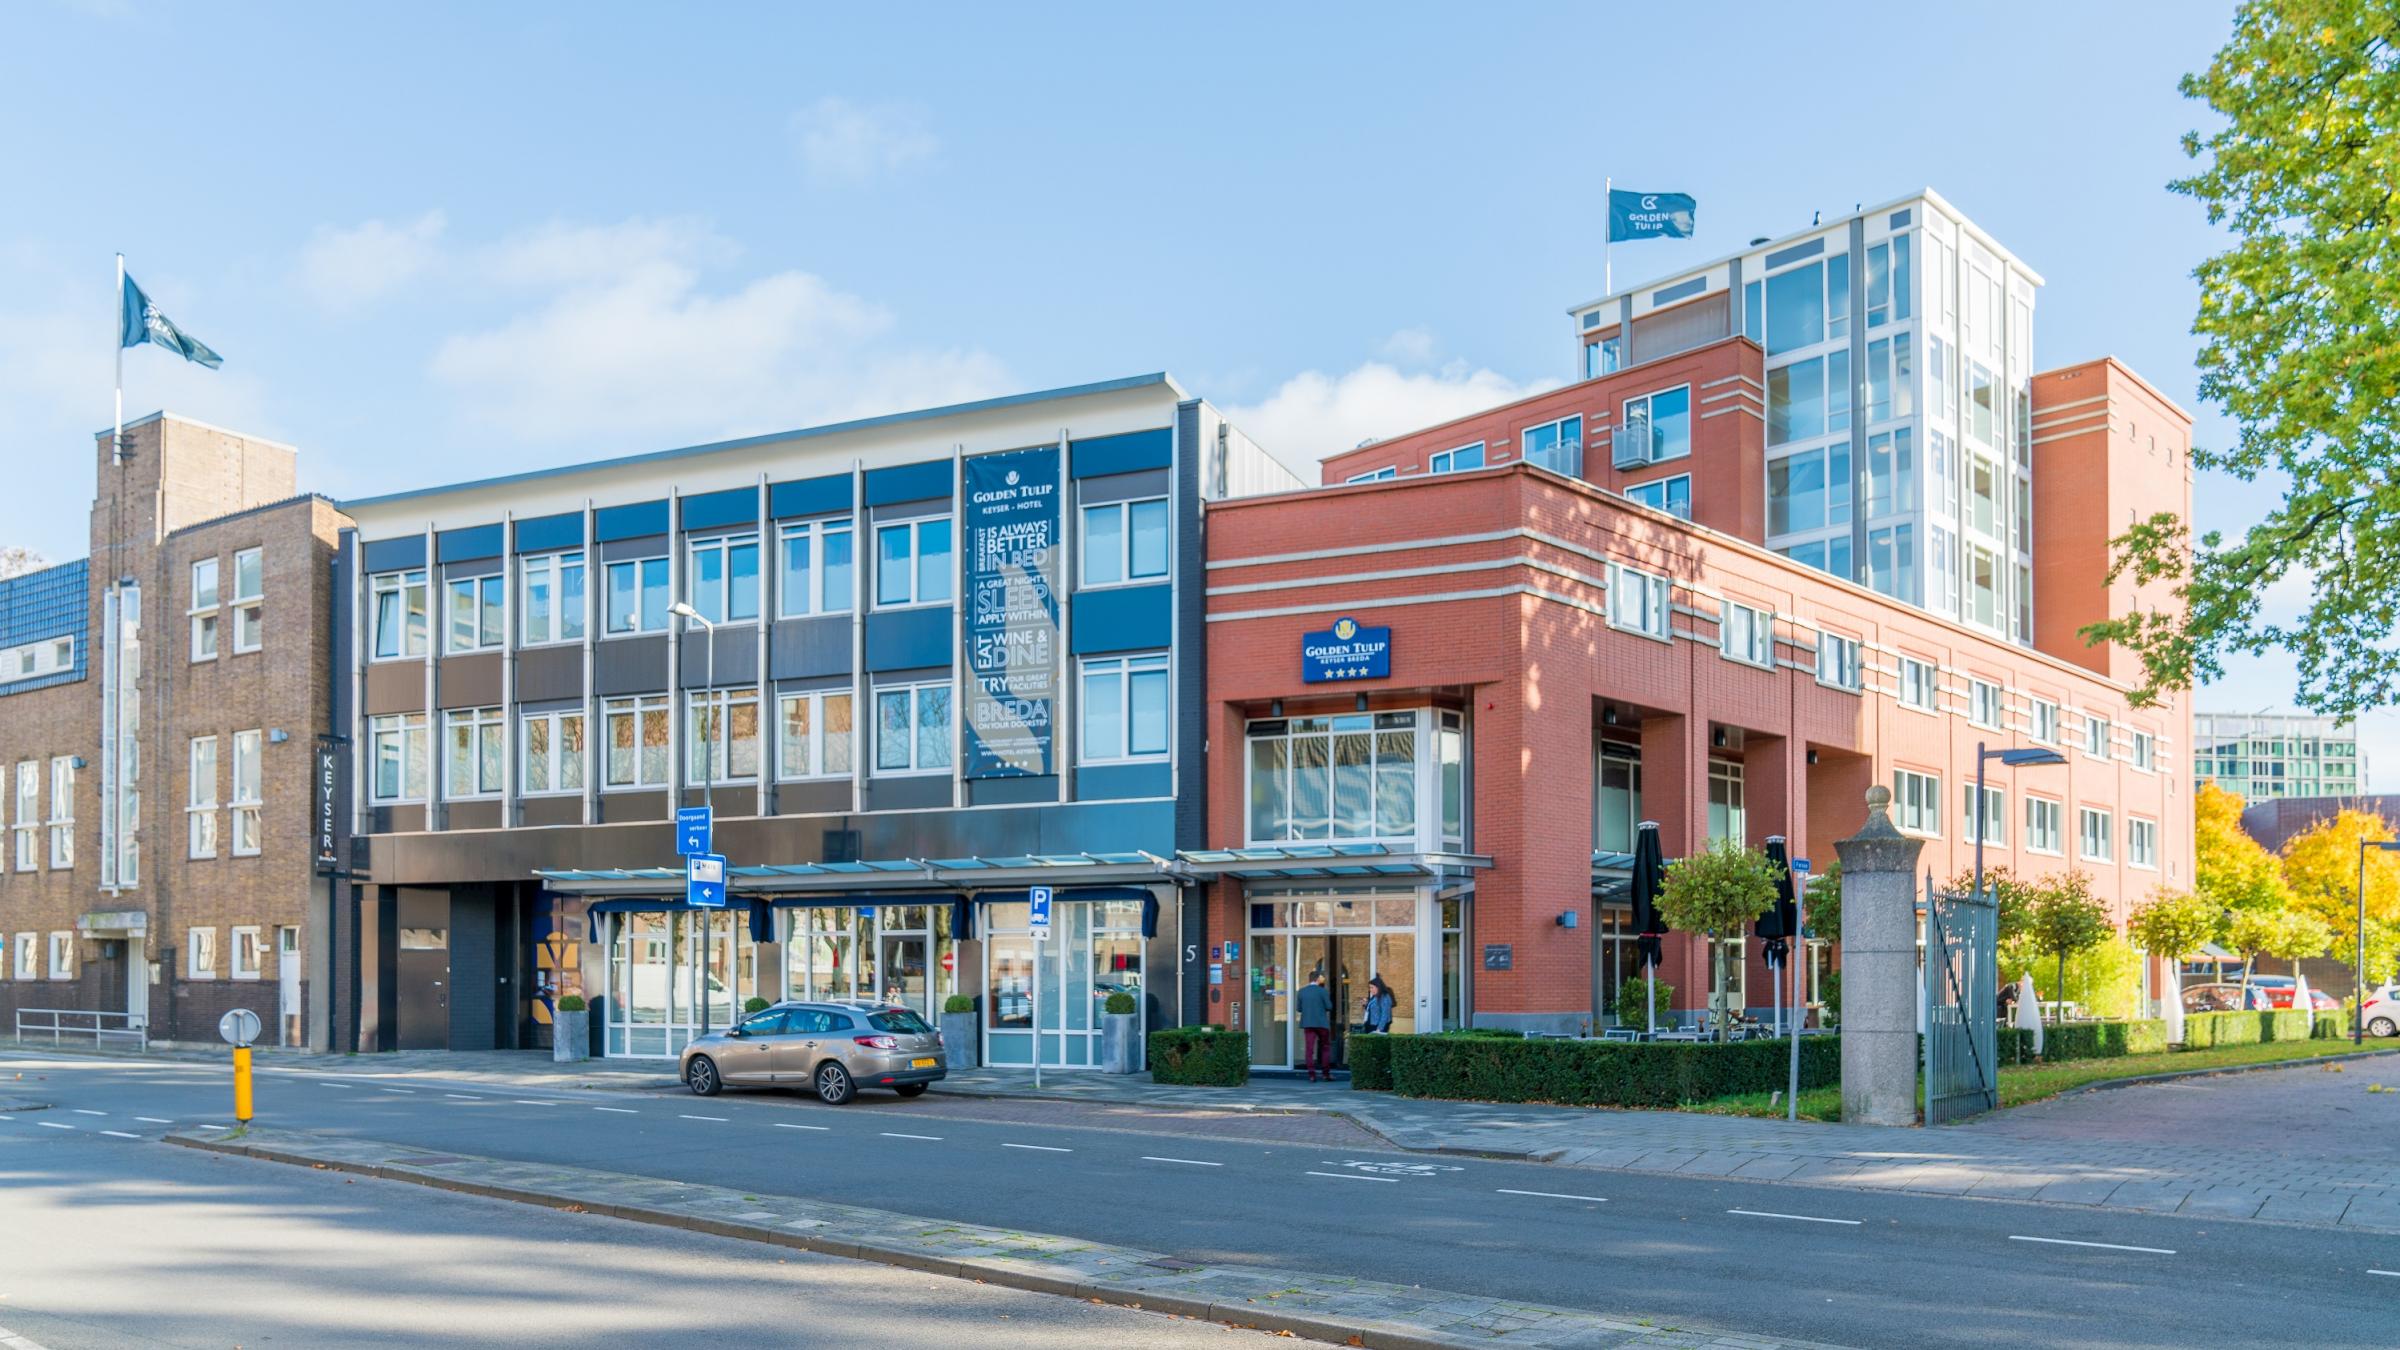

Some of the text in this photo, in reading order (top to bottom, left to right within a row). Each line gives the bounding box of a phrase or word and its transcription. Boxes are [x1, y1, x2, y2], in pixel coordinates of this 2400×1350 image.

[1629, 213, 1669, 221] GOLDEN
[973, 485, 1053, 503] GOLDEN TULIP
[983, 504, 1009, 514] KEYSER
[1017, 500, 1043, 510] HOTEL
[987, 520, 1048, 539] IS ALWAYS
[987, 532, 1048, 554] BETTER
[987, 548, 1048, 572] IN BED
[978, 581, 985, 590] A
[986, 577, 1012, 589] GREAT
[977, 583, 1049, 615] SLEEP
[978, 608, 1048, 625] APPLY WITHIN
[992, 629, 1048, 646] WINE &
[977, 634, 993, 669] EAT
[992, 643, 1049, 668] DINE
[1305, 641, 1386, 657] GOLDEN TULIP
[978, 676, 1009, 693] TRY
[977, 698, 1049, 722] BREDA
[978, 718, 1048, 730] ON YOUR DOORSTEP
[323, 755, 333, 848] KEYSER
[679, 813, 706, 821] Doorgaand
[1034, 890, 1047, 910] P
[1185, 944, 1197, 962] 5
